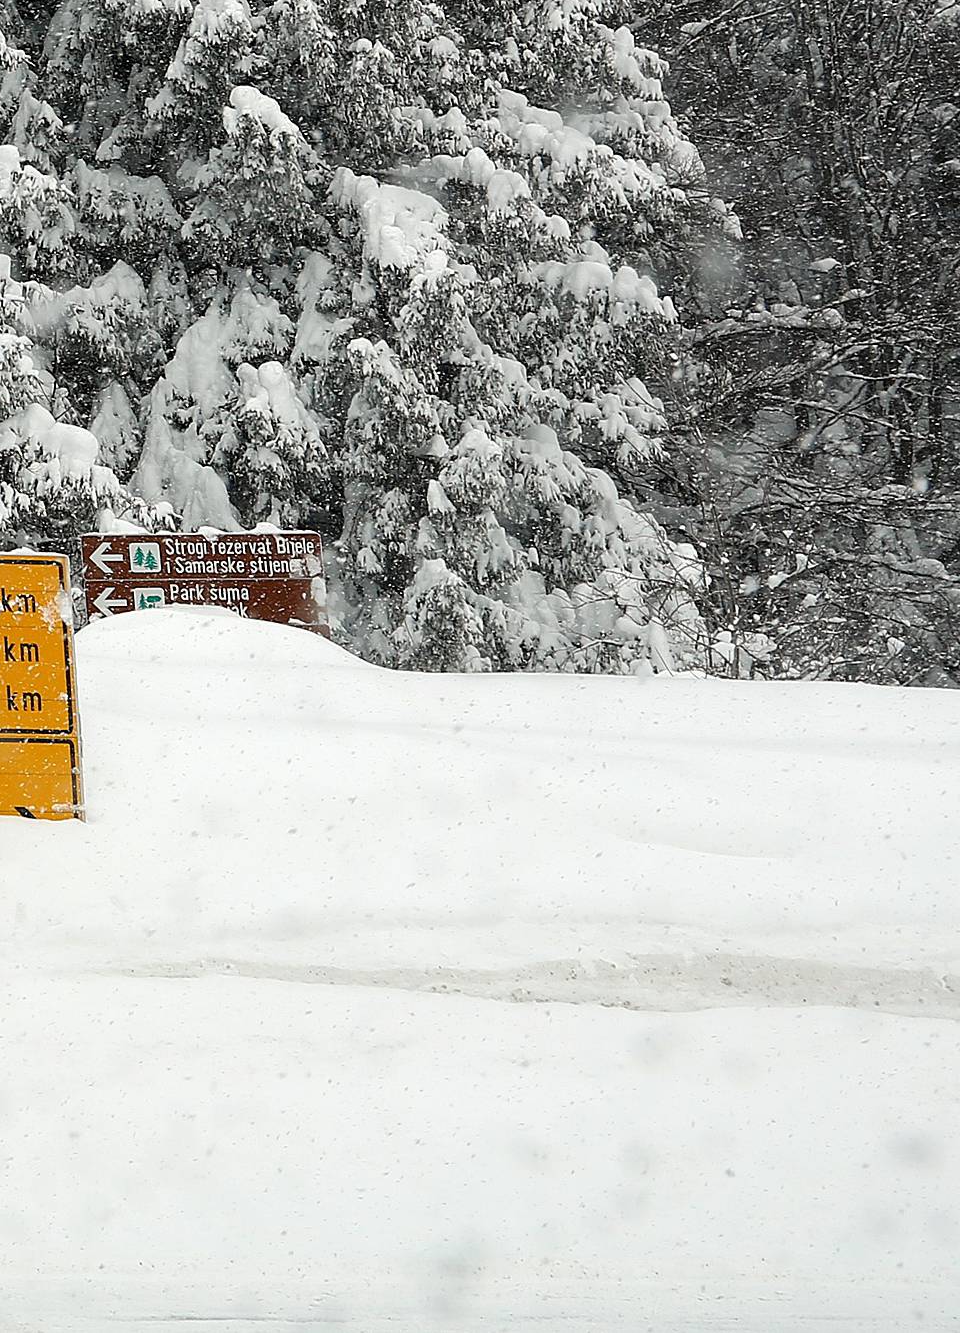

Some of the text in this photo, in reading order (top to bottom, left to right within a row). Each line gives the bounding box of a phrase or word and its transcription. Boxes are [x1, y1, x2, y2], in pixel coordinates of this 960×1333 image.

[165, 538, 315, 557] Strogi rezervat Bijele
[166, 560, 171, 574] i
[176, 559, 245, 574] Samarske
[0, 588, 37, 613] km
[170, 583, 205, 601] Park
[3, 636, 40, 662] km
[7, 686, 43, 712] km
